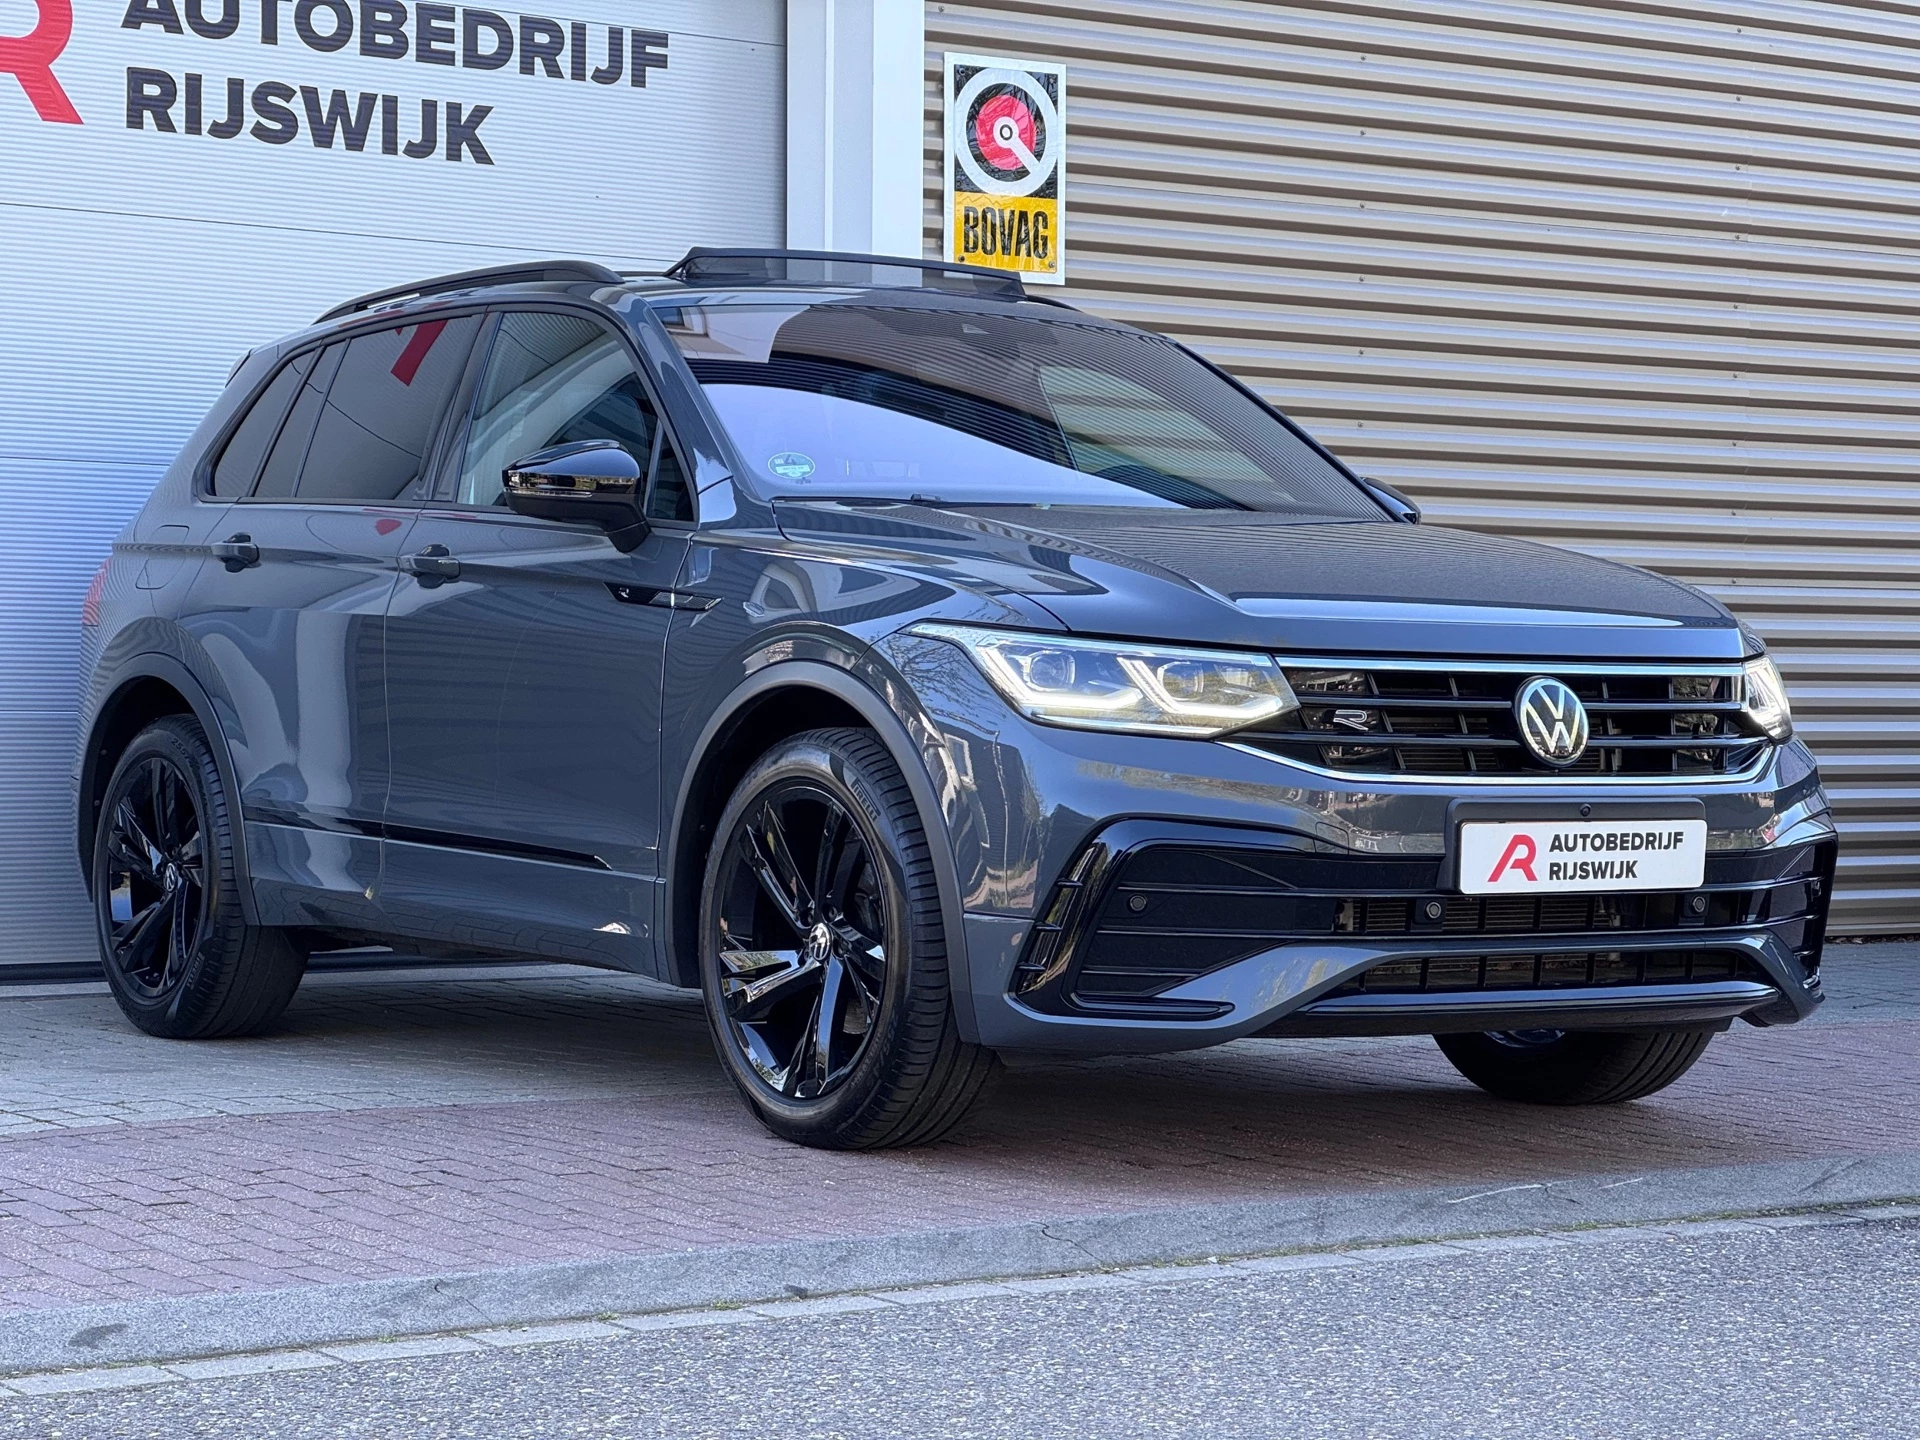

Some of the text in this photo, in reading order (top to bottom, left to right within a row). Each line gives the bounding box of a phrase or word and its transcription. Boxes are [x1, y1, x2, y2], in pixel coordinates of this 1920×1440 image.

[126, 66, 495, 165] RIJSWIJK
[963, 206, 1048, 259] BOVAG
[850, 777, 881, 823] PIRELLI
[1549, 832, 1684, 852] AUTOBEDRIJF
[1549, 860, 1638, 881] RIJSWIJK
